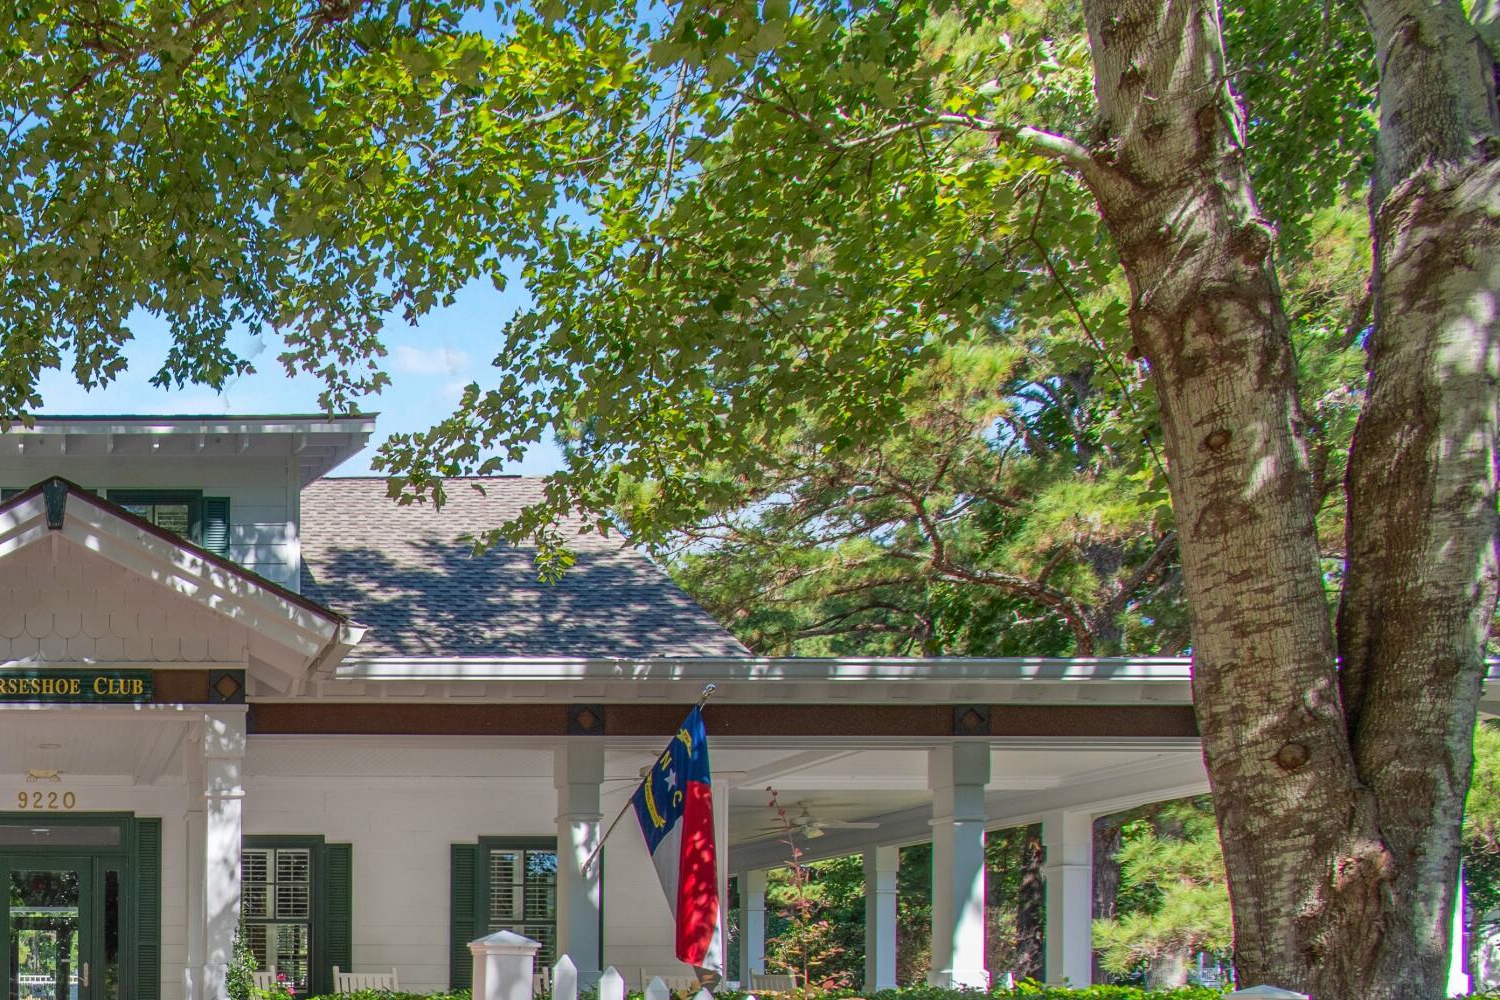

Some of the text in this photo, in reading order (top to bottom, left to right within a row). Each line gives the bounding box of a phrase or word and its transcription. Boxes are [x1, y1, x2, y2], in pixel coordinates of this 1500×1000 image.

[93, 675, 145, 696] CLUB
[660, 750, 673, 771] N
[17, 791, 77, 810] 9220
